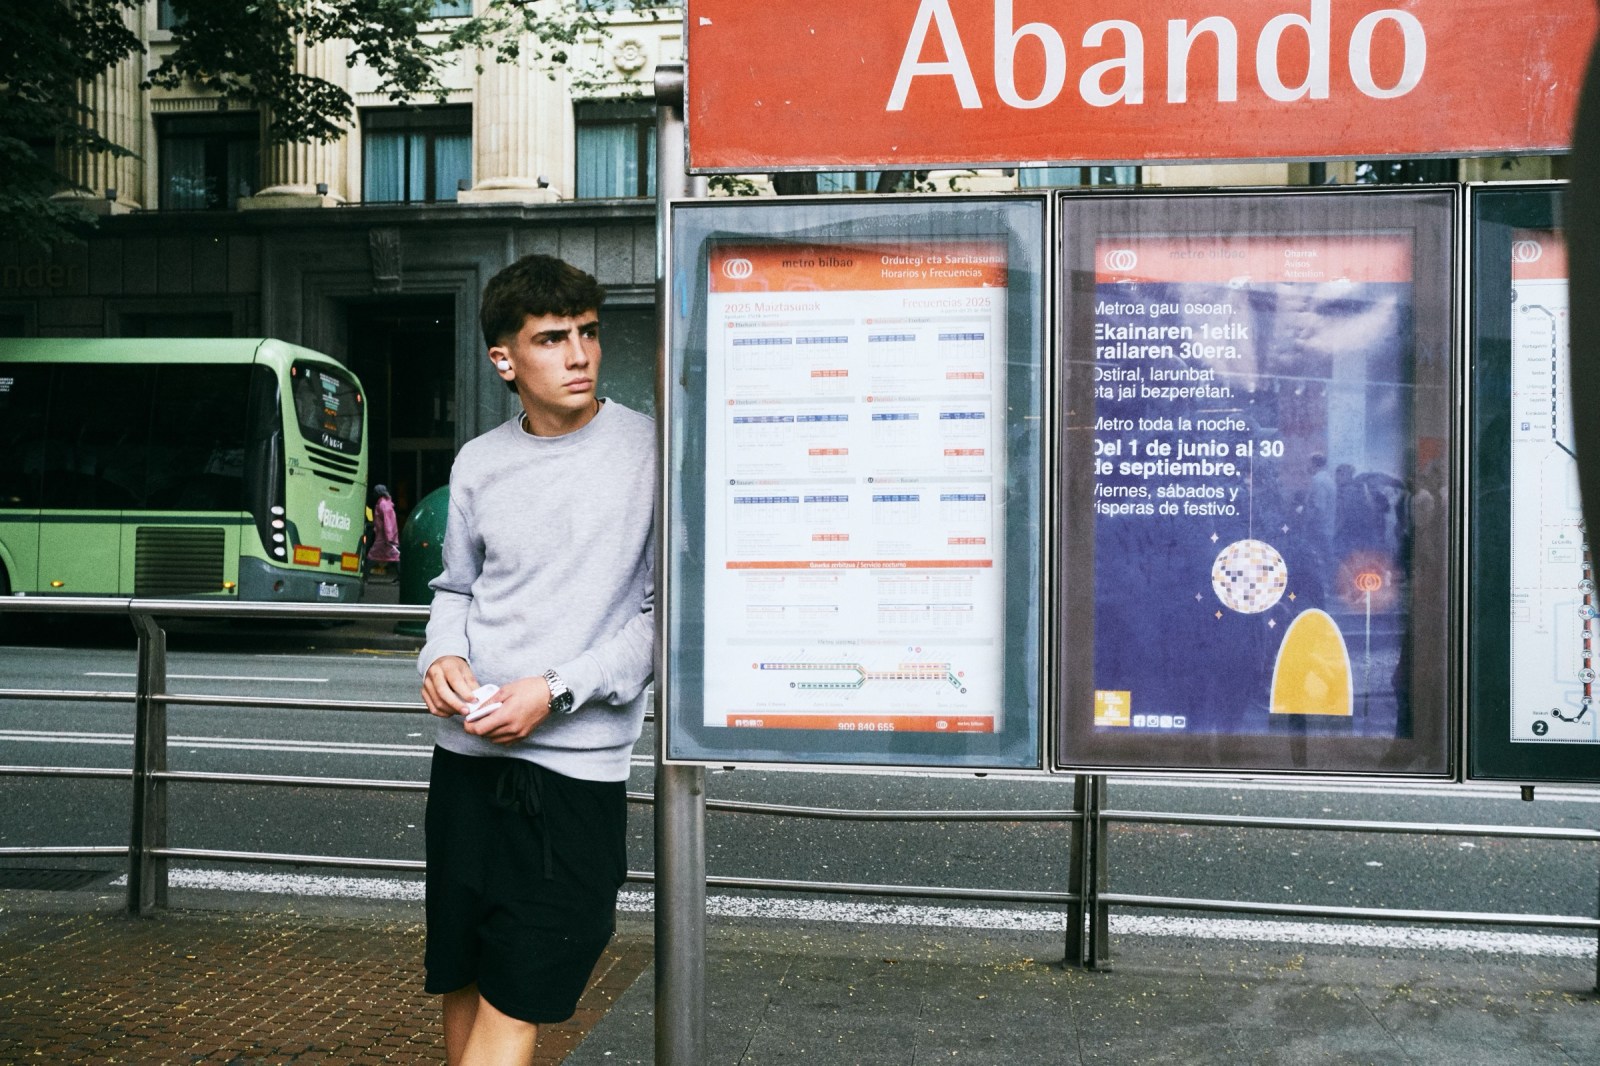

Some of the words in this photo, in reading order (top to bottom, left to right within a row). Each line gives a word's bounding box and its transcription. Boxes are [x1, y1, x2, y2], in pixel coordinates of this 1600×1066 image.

[886, 0, 1427, 112] Abando
[1169, 249, 1204, 259] metro
[1209, 247, 1245, 259] bilbao
[782, 258, 815, 268] metro
[819, 257, 853, 268] bilbao
[881, 255, 924, 267] Ordutegi
[927, 255, 942, 264] eta
[881, 268, 919, 278] Horarios
[922, 270, 927, 279] y
[930, 268, 983, 278] Frecuencias
[725, 303, 751, 313] 2025
[754, 302, 821, 312] Maiztasunak
[902, 298, 962, 308] Frecuencias
[965, 297, 991, 308] 2025
[1150, 303, 1179, 318] gau
[1184, 302, 1237, 315] osoan.
[1095, 323, 1193, 340] Ekainaren
[1200, 323, 1249, 340] 1etik
[1179, 342, 1242, 359] 30era.
[1150, 367, 1215, 381] larunbat
[1118, 383, 1136, 402] jai
[1141, 382, 1235, 402] bezperetan.
[1138, 417, 1174, 431] toda
[1178, 416, 1192, 431] la
[1197, 416, 1250, 431] noche.
[1128, 439, 1138, 456] 1
[1145, 439, 1172, 456] de
[1176, 439, 1230, 460] junio
[1235, 440, 1253, 457] al
[1259, 440, 1285, 457] 30
[1119, 459, 1241, 479] septiembre.
[1157, 483, 1225, 498] sábados
[1229, 487, 1239, 501] y
[1094, 499, 1154, 517] ísperas
[1159, 501, 1179, 515] de
[1184, 501, 1240, 516] festivo.
[838, 722, 855, 731] 900
[858, 722, 875, 731] 840
[877, 722, 895, 731] 655
